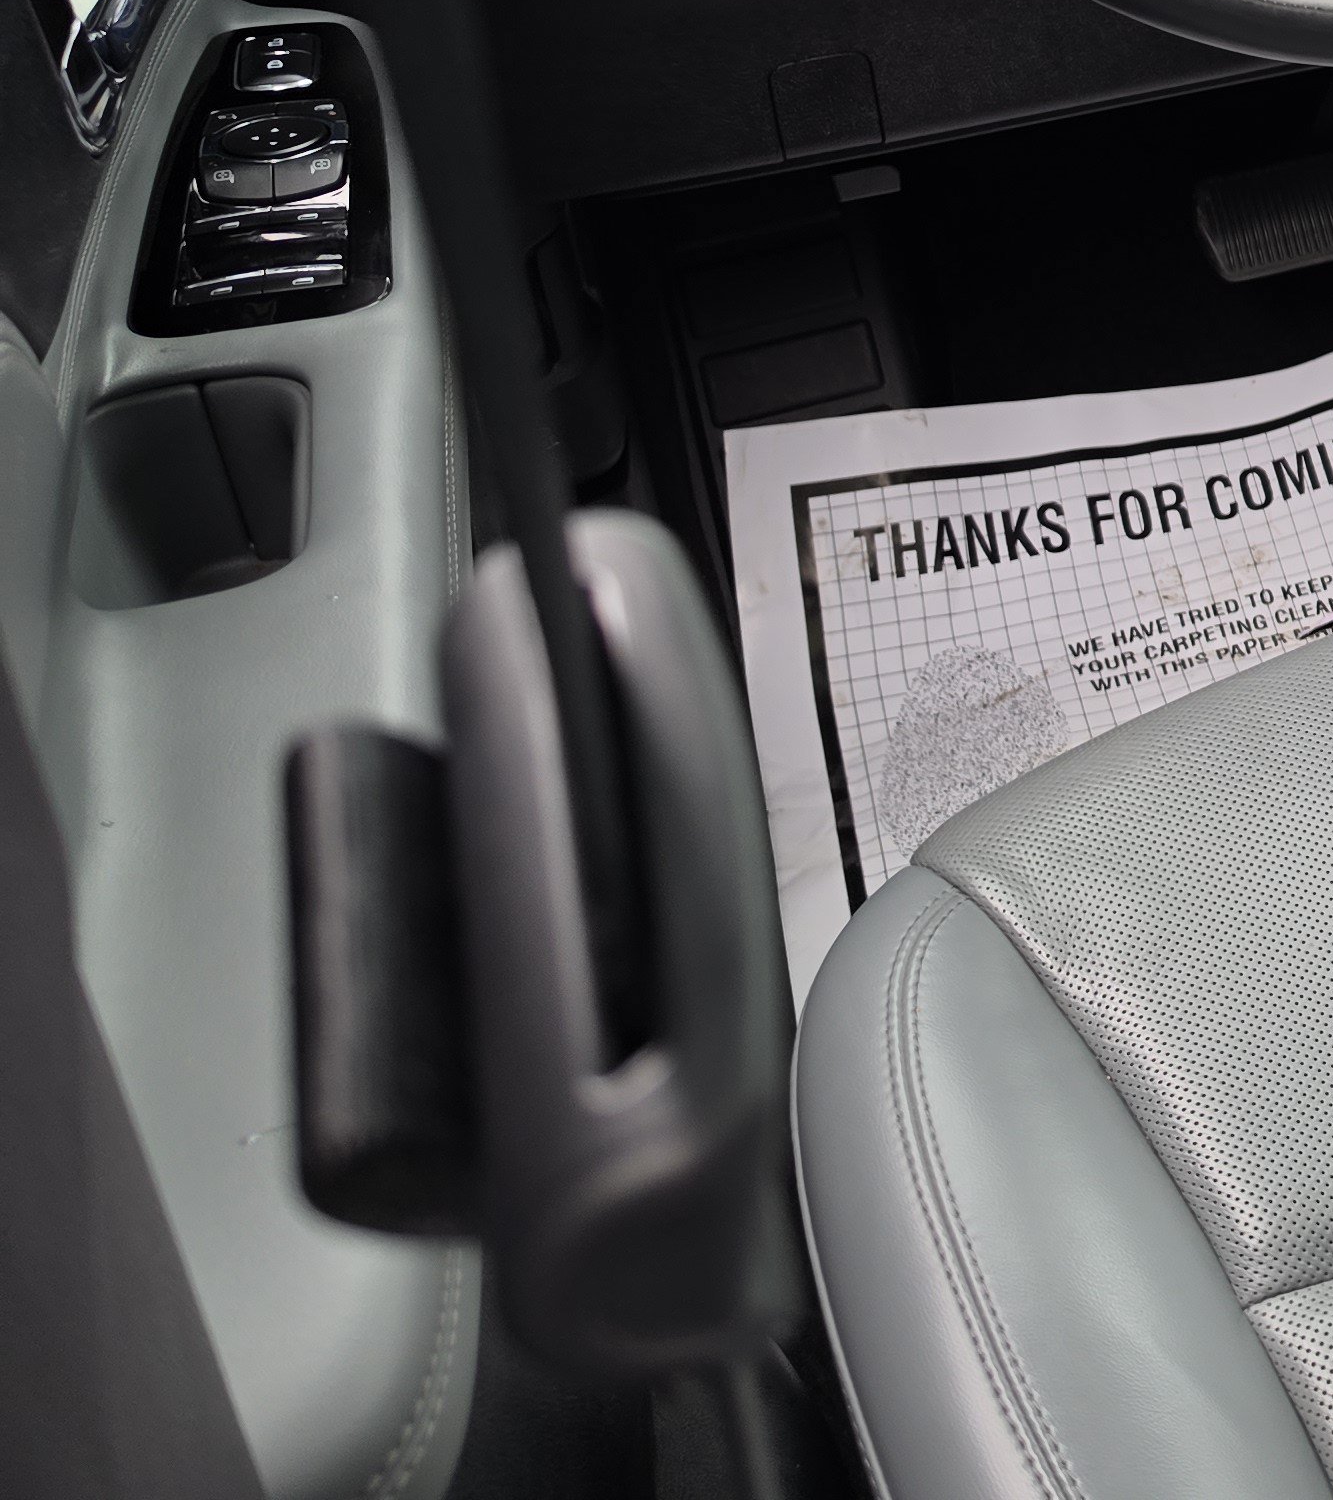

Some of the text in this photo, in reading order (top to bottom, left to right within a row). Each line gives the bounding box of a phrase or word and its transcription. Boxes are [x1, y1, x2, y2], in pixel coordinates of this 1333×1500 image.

[854, 500, 1071, 583] THANKS
[1085, 481, 1193, 546] FOR
[1068, 574, 1333, 658] WE HAVE TRIED TO KEEP
[1073, 651, 1137, 676] YOUR
[1144, 614, 1269, 661] CARPETING
[1090, 670, 1151, 693] WITH
[1156, 650, 1209, 676] THIS
[1216, 631, 1287, 660] PAPER
